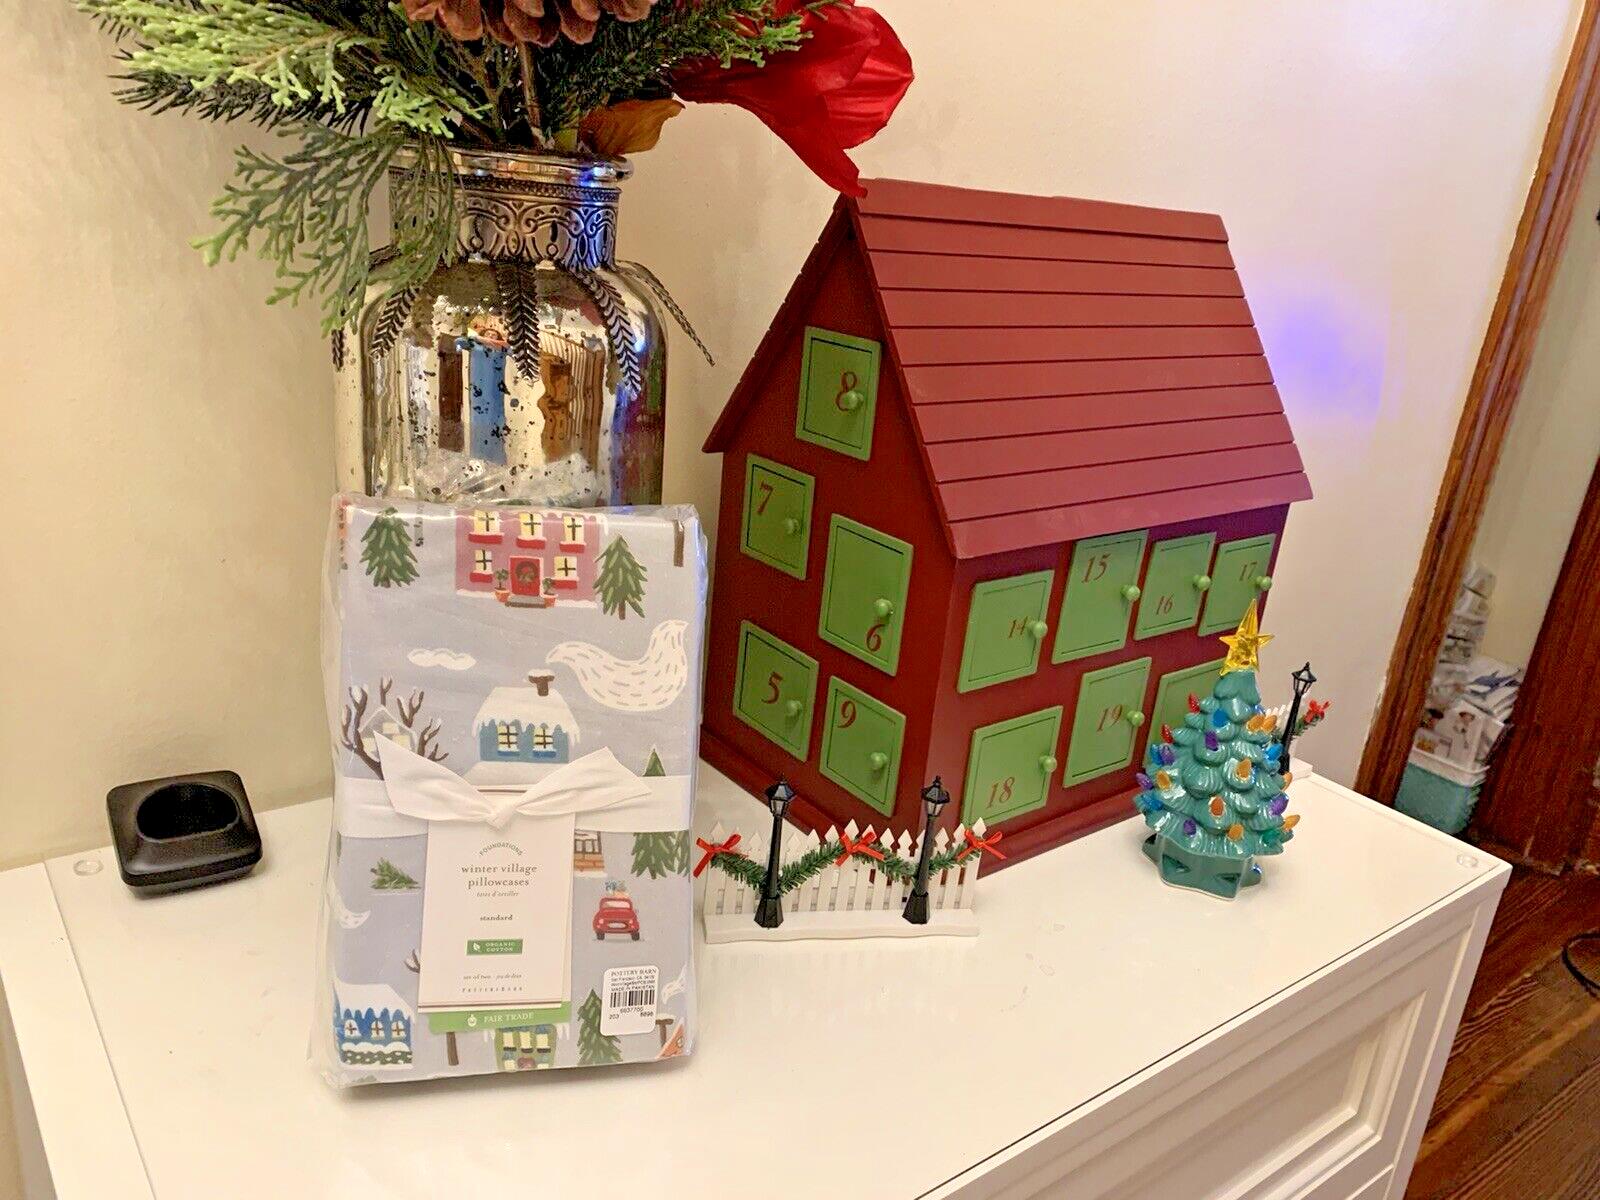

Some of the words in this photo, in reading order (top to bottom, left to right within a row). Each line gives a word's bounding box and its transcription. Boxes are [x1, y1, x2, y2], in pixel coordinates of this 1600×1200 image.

[835, 370, 860, 412] 8
[757, 481, 774, 515] 7
[1081, 552, 1111, 584] 15
[1239, 561, 1257, 582] 17
[1155, 592, 1175, 616] 16
[866, 621, 886, 653] 6
[1008, 615, 1030, 639] 14
[761, 671, 784, 705] 5
[837, 700, 857, 729] 9
[1096, 703, 1122, 733] 19
[985, 776, 1016, 809] 18
[479, 842, 523, 856] FOUNDATIONS
[461, 864, 498, 873] winter
[501, 863, 538, 876] village
[468, 877, 530, 890] pillowcases
[484, 1014, 503, 1023] FAIR
[505, 1011, 535, 1021] TRADE
